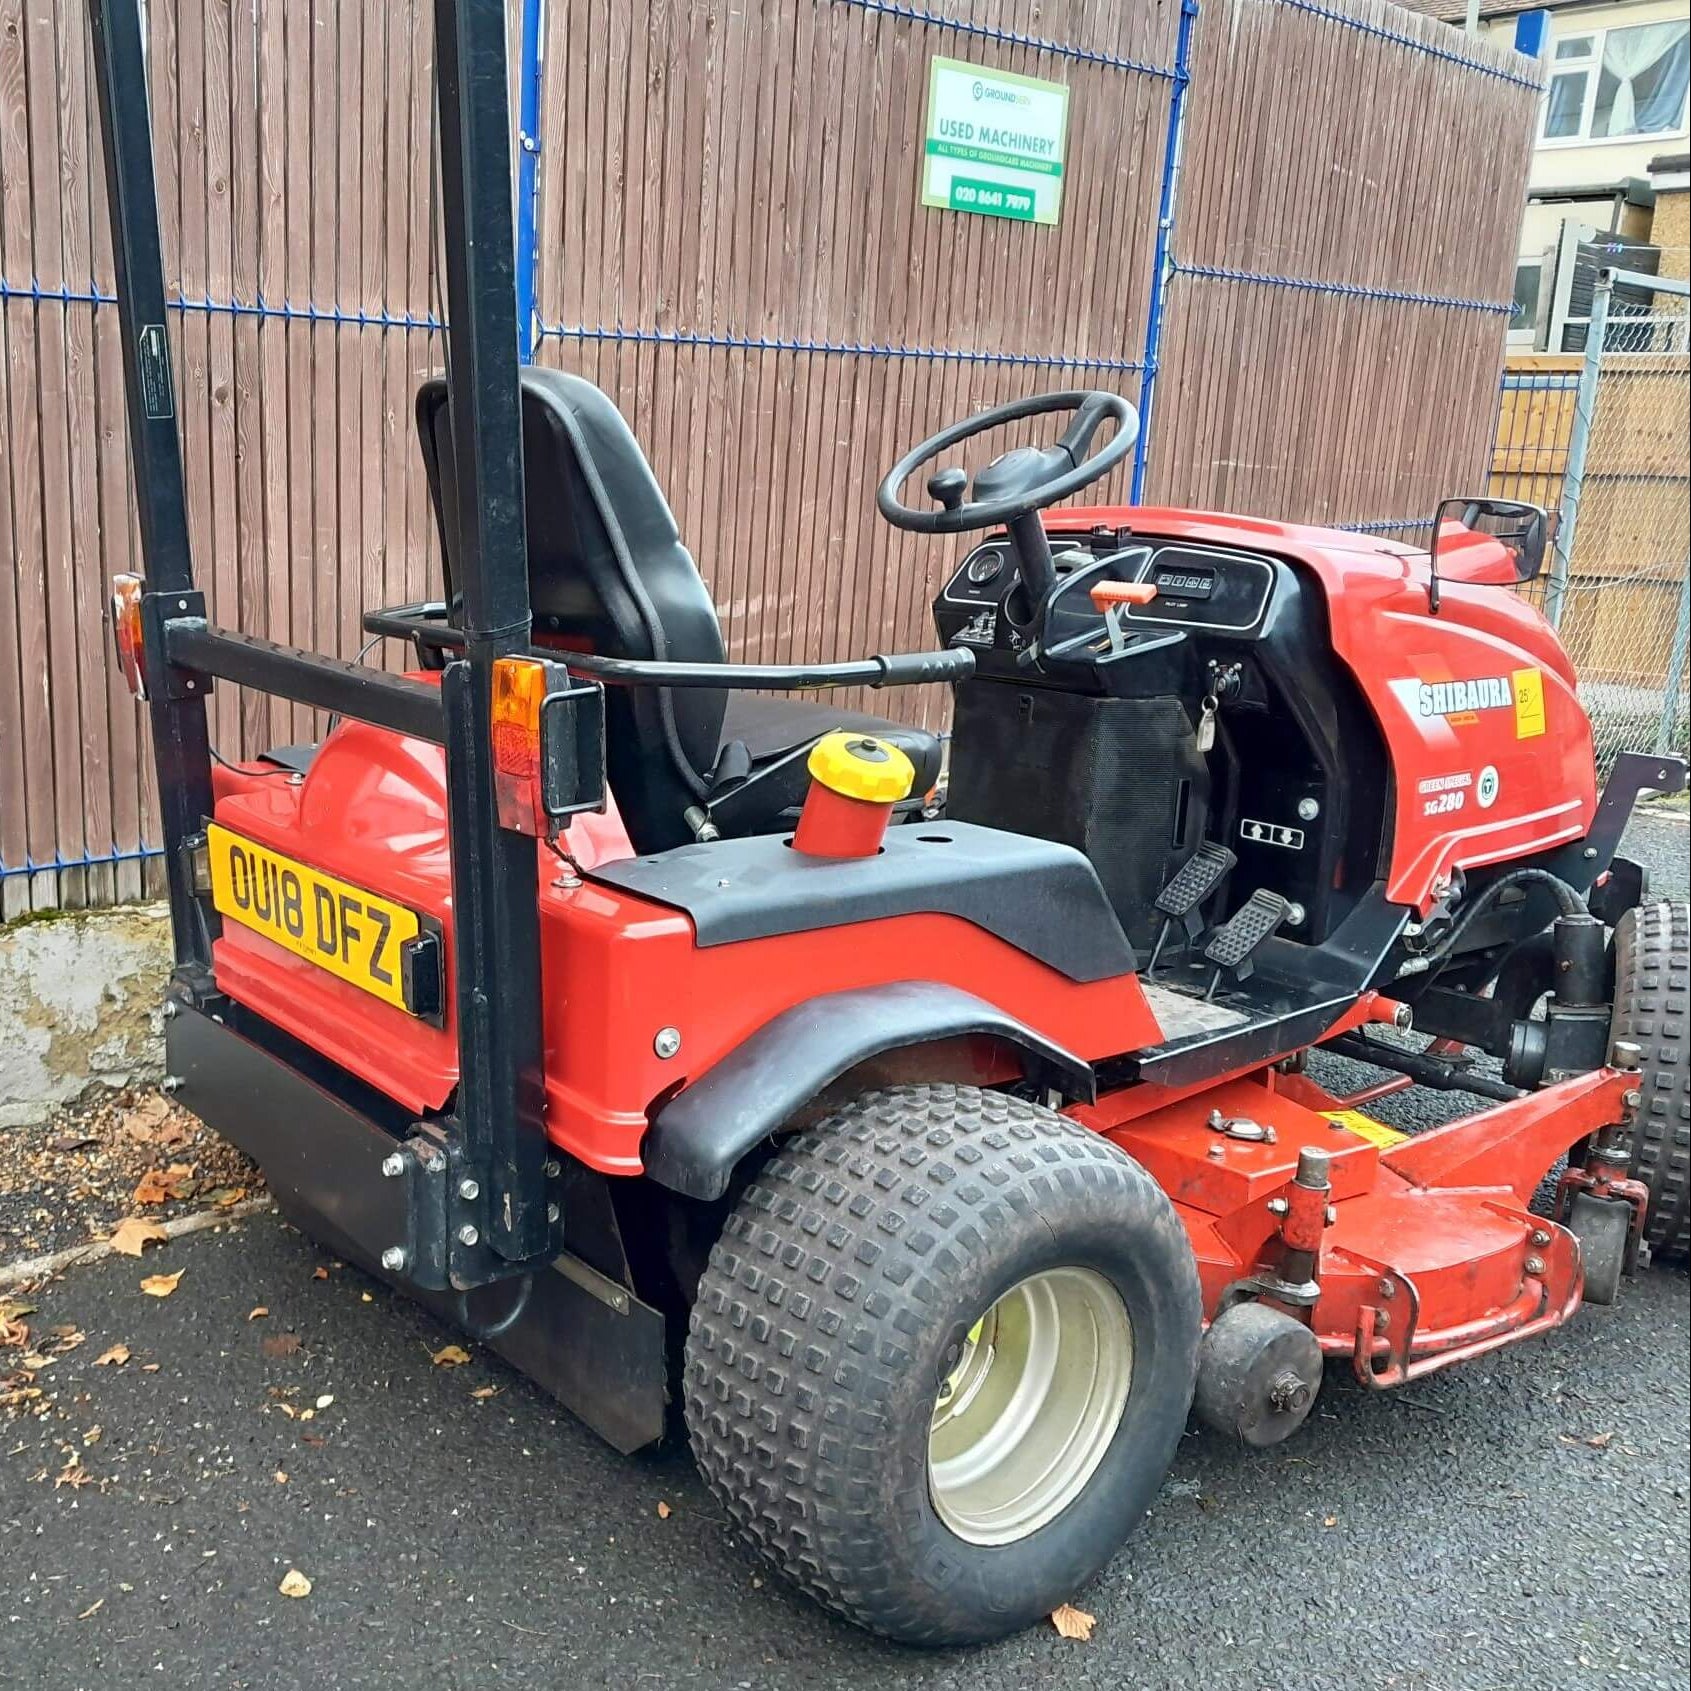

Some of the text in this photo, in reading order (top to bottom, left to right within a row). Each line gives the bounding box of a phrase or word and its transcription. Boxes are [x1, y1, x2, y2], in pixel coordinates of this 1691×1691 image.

[939, 118, 1055, 156] USED MACHINERY
[937, 143, 948, 154] ALL
[949, 145, 968, 158] TYPES
[968, 149, 978, 159] OF
[1019, 158, 1053, 173] MACHINERY
[955, 186, 977, 203] 020
[977, 189, 1003, 207] 8641
[1419, 677, 1513, 717] SHIBAURA
[1423, 790, 1465, 817] SG280
[229, 844, 393, 987] OU18 DFZ
